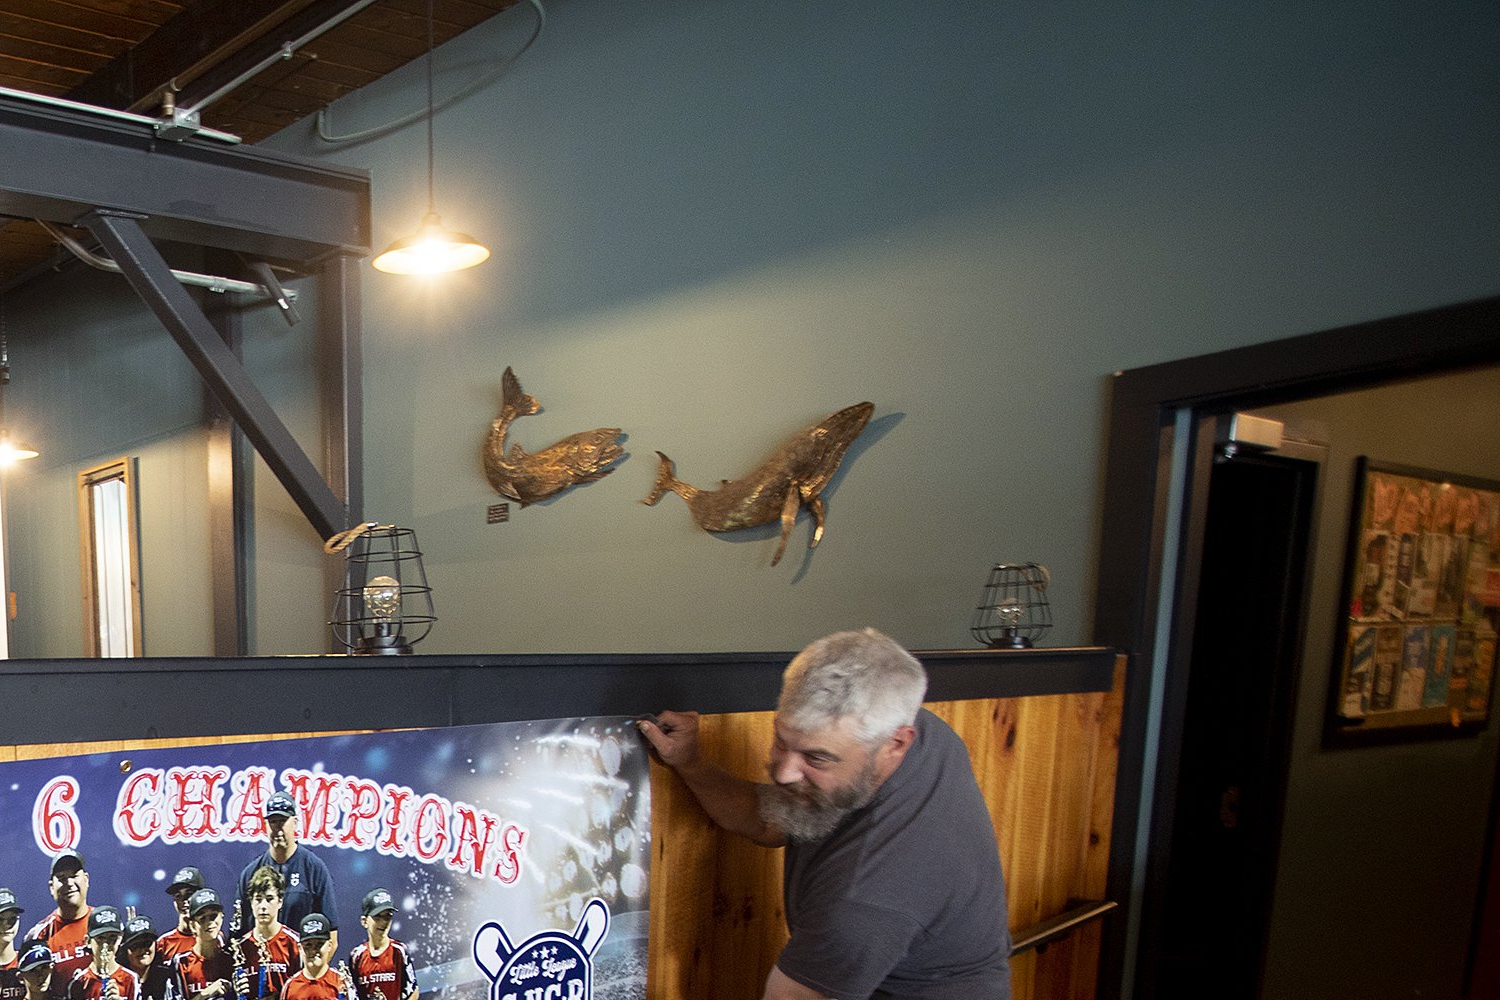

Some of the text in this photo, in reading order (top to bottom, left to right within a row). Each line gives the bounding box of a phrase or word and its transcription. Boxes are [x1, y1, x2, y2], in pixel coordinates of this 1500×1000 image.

[34, 780, 75, 853] 6
[116, 769, 526, 884] CHAMPIONS
[509, 957, 577, 985] Little League
